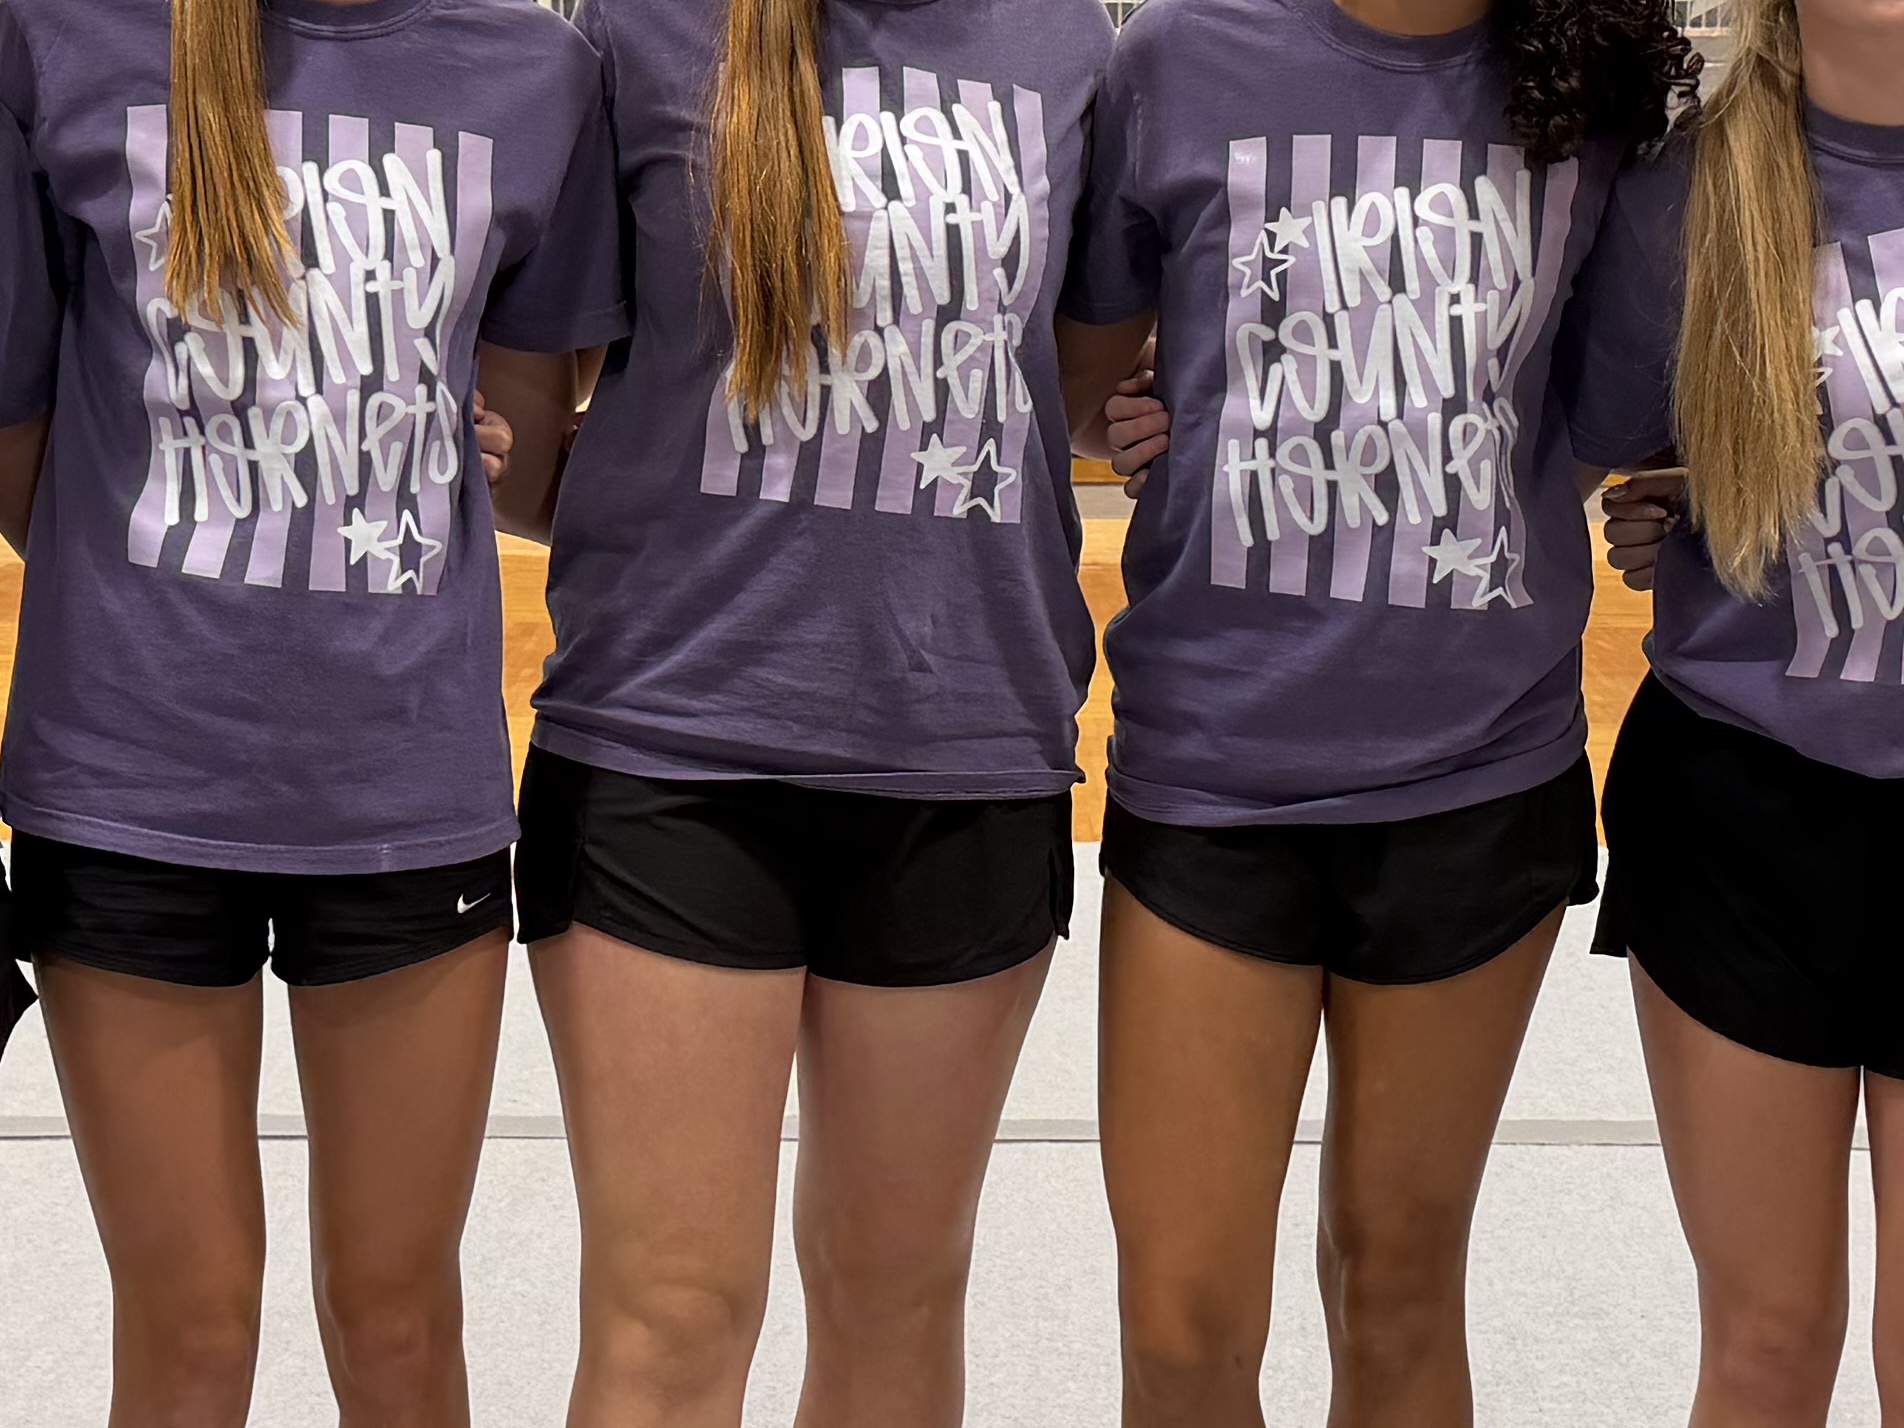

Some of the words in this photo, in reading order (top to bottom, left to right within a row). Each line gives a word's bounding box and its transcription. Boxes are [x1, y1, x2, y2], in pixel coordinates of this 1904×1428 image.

[271, 148, 452, 277] ION
[823, 100, 1020, 212] RION
[849, 191, 1031, 328] UNTY
[1312, 168, 1533, 314] IRION
[1236, 277, 1536, 431] COUNTY
